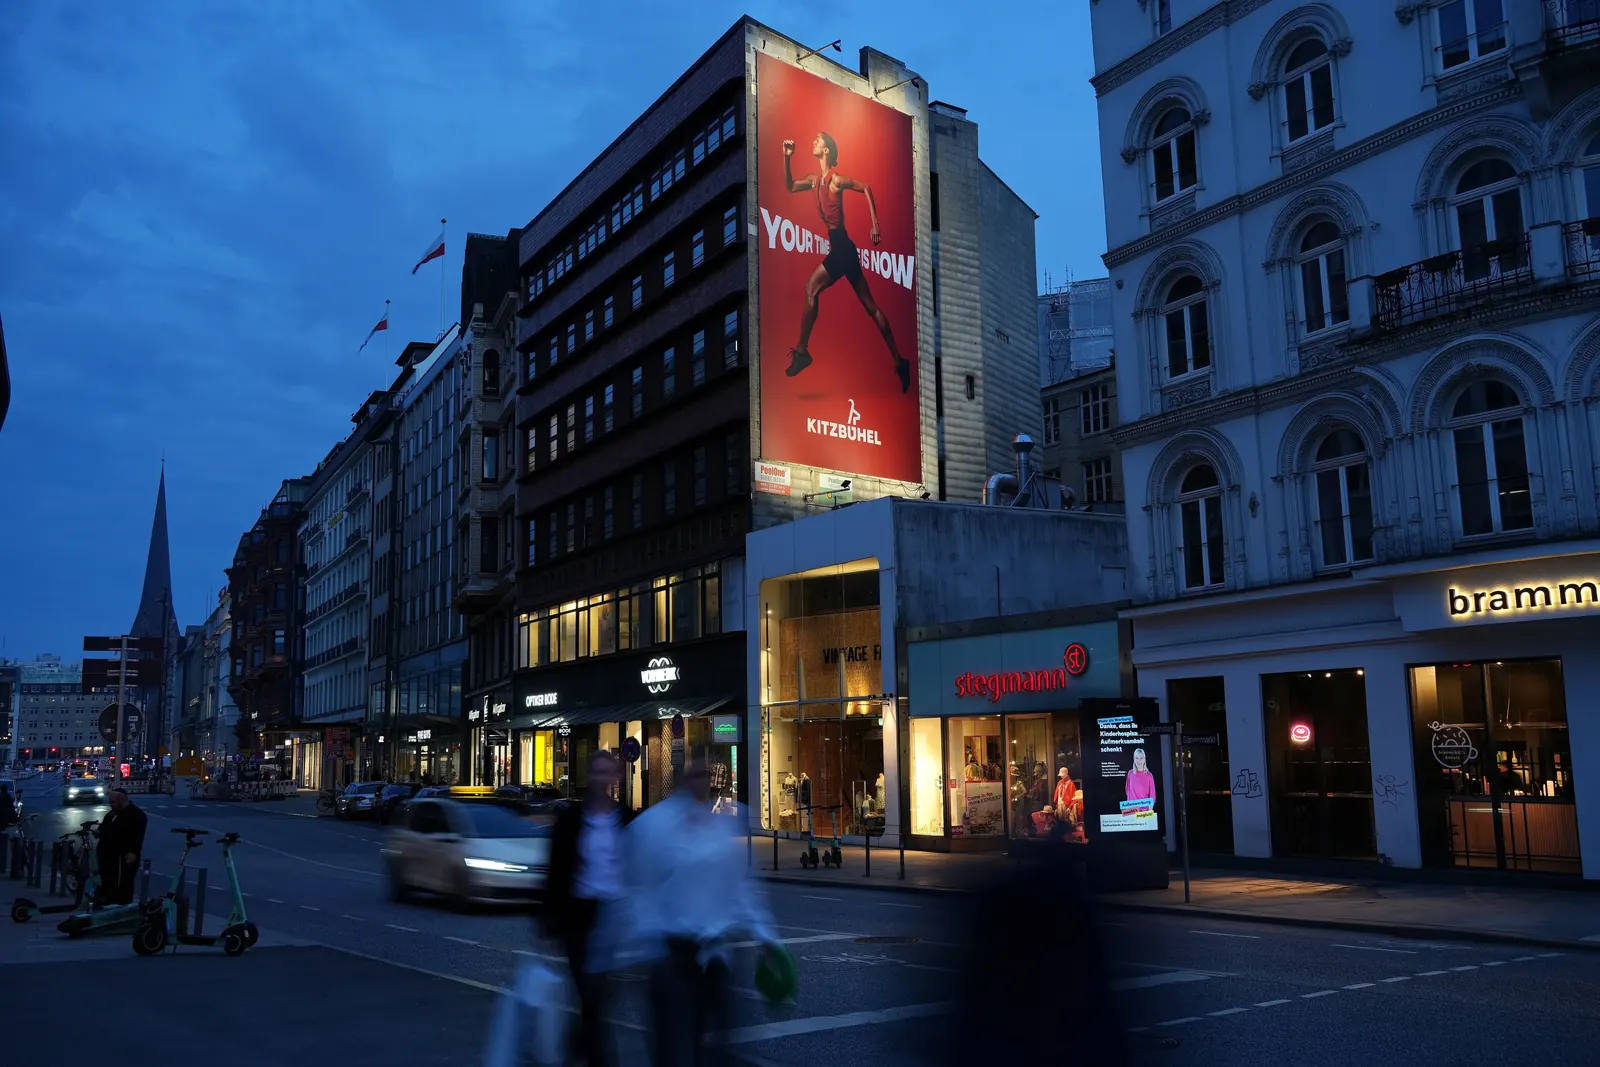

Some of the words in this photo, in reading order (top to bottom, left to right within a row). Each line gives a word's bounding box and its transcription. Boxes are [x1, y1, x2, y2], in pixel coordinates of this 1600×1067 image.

[759, 206, 813, 254] YOUR
[861, 248, 870, 270] IS
[871, 250, 915, 290] NOW
[807, 417, 882, 446] KITZBÜHEL
[760, 465, 785, 477] PoolOne
[1448, 581, 1600, 616] bramm
[822, 645, 868, 664] VINTAGE
[873, 644, 882, 661] F
[525, 694, 544, 708] OPTIKER
[544, 692, 558, 705] BODE
[955, 668, 1066, 703] stegmann
